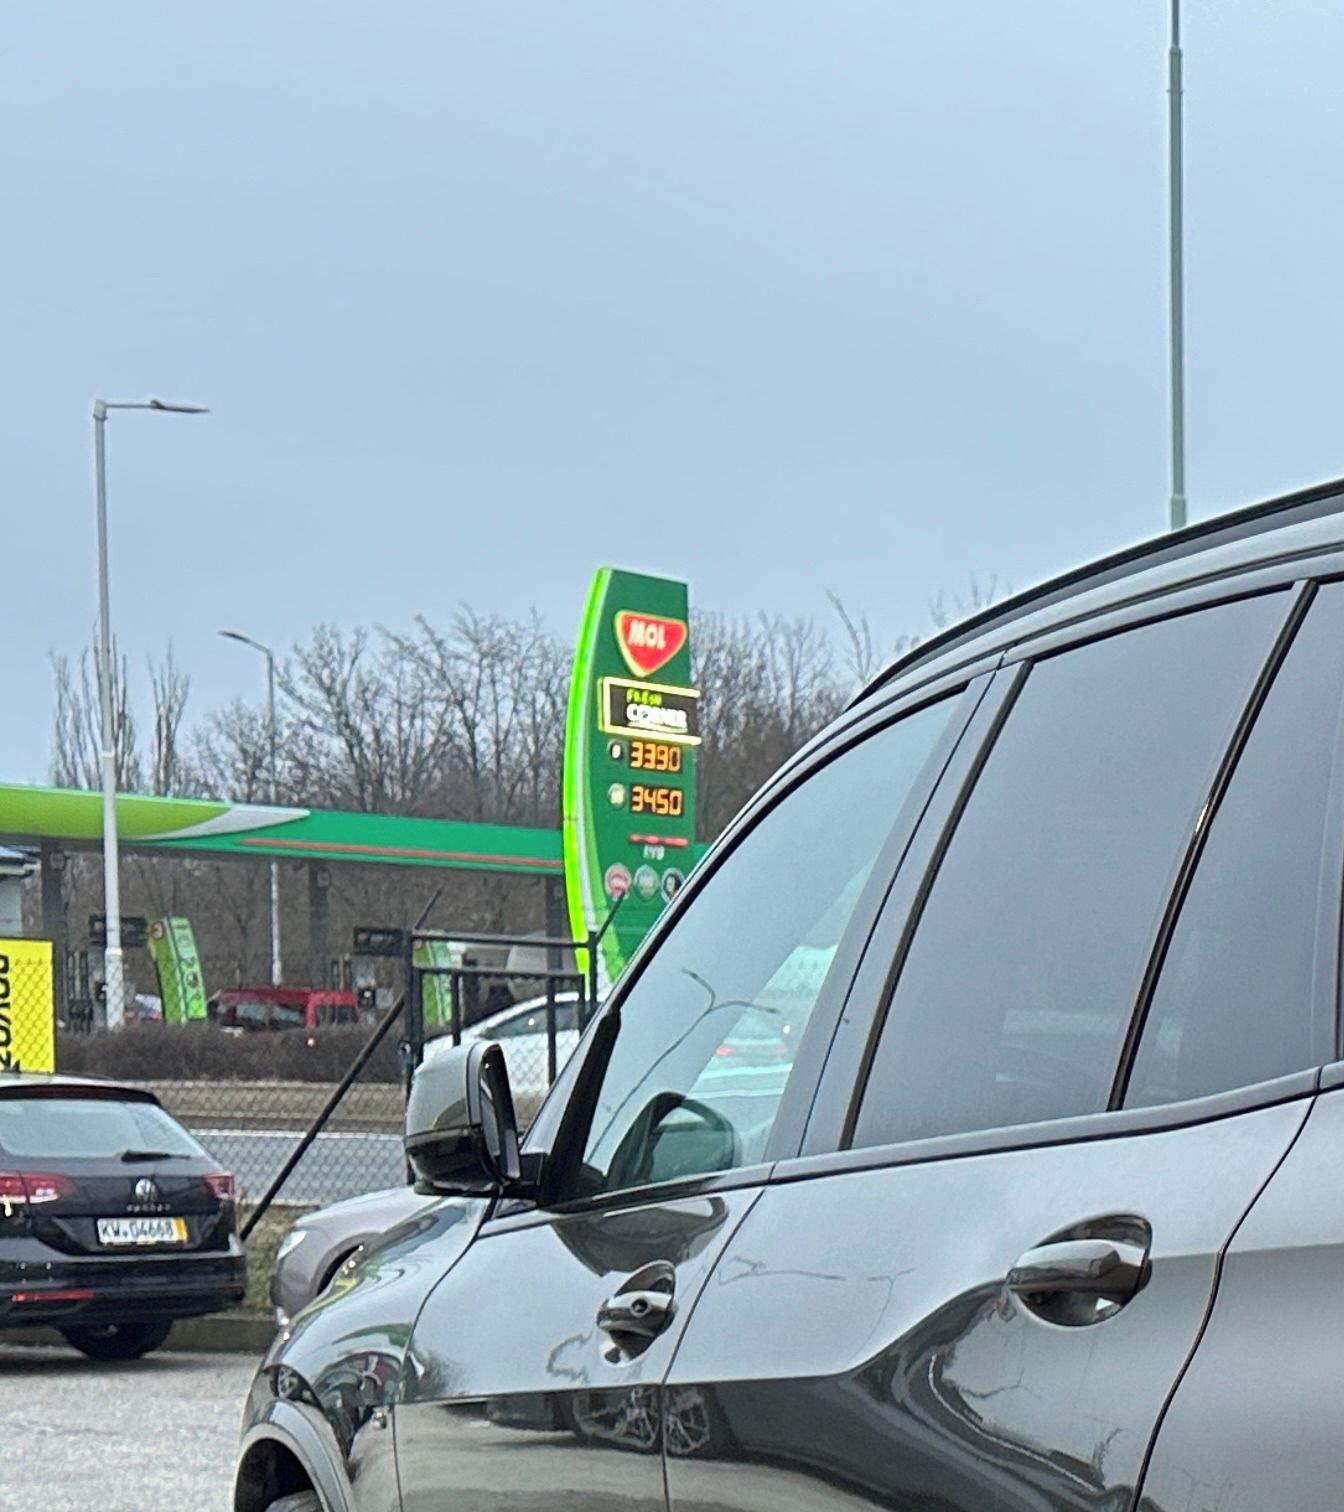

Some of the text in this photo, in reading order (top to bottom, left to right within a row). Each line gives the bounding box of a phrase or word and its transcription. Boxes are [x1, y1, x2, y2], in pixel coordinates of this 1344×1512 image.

[628, 619, 667, 650] MOL
[630, 740, 681, 773] 3390
[631, 785, 684, 816] 3450
